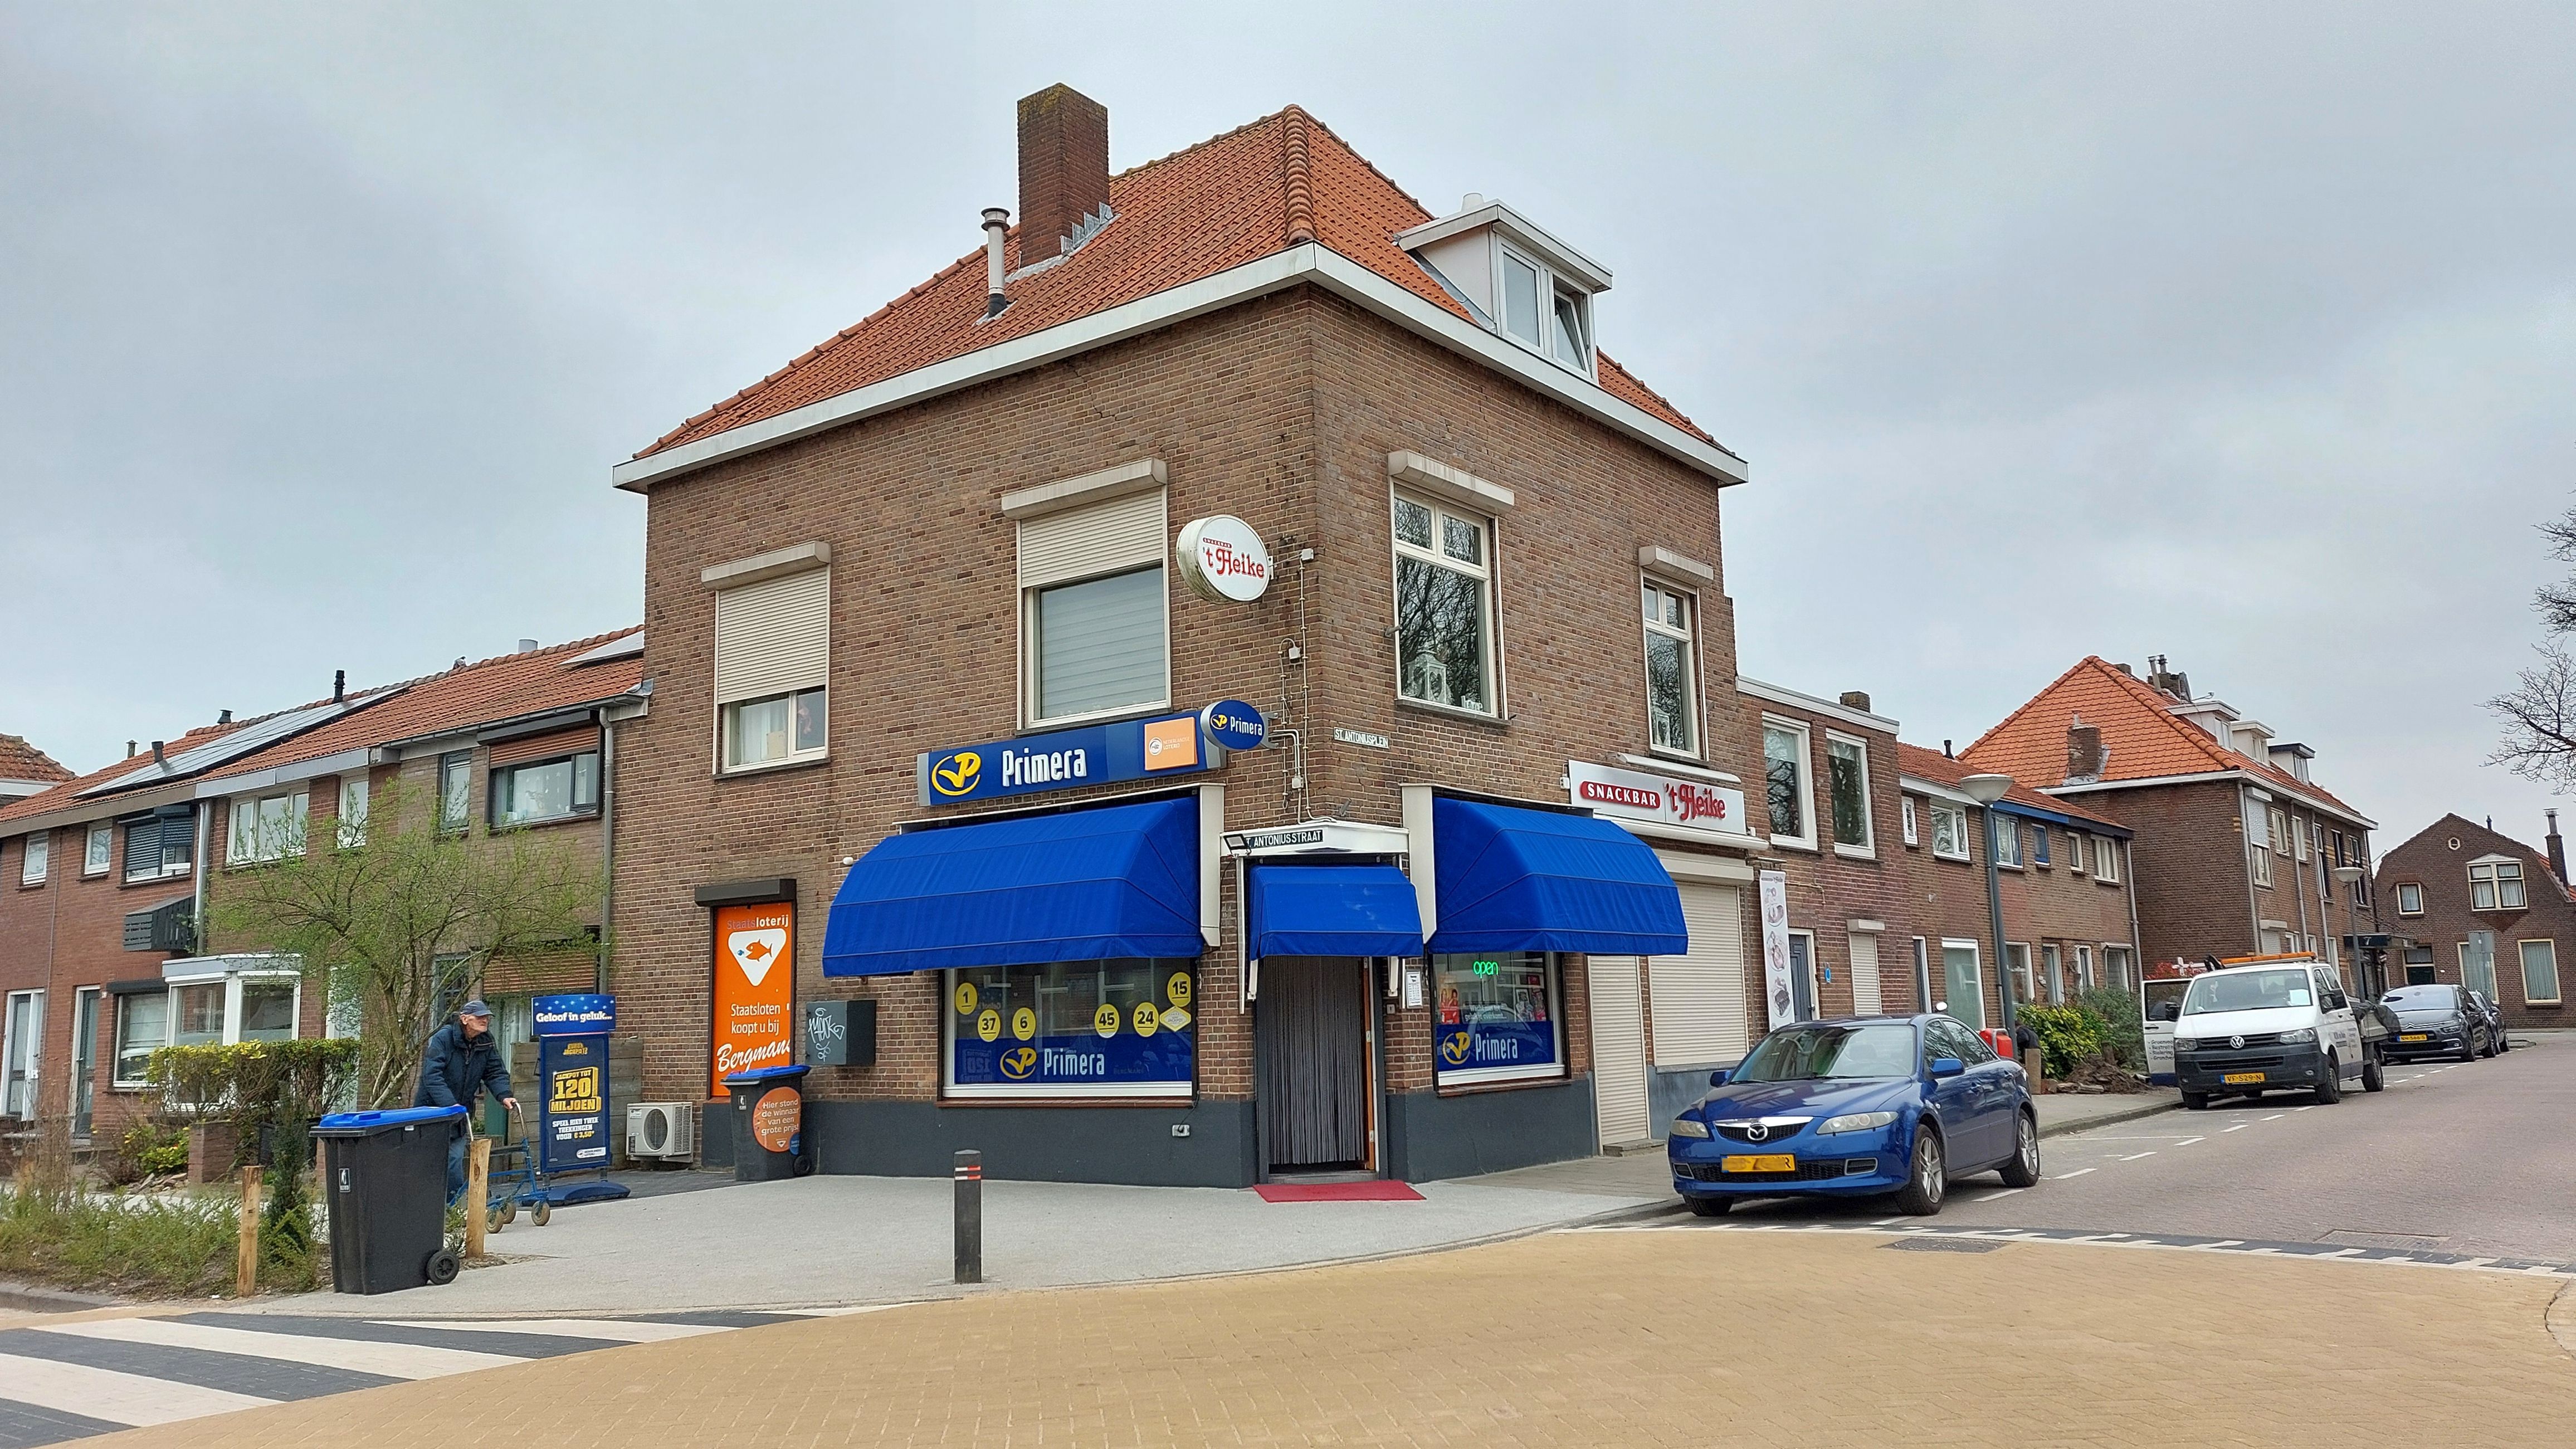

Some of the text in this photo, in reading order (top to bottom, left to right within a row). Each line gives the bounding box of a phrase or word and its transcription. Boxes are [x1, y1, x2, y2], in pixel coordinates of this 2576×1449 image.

[1203, 547, 1265, 579] 't Heike
[1230, 716, 1262, 736] Primera
[1345, 730, 1389, 748] ANTONIUSPLEIN
[1002, 748, 1087, 787] Primera
[1587, 783, 1657, 806] SNACKBAR
[1665, 783, 1726, 821] 't Heike
[1253, 830, 1321, 847] ANTONIUSSTRAAT
[727, 914, 789, 930] Staatsloterij
[1473, 961, 1499, 978] open
[1172, 981, 1188, 996] 15
[962, 991, 968, 1003] 1
[536, 1011, 612, 1023] Geloof in geluk...
[731, 1002, 780, 1017] Staatsloten
[982, 1018, 996, 1031] 37
[1019, 1017, 1028, 1029] 6
[1099, 1012, 1115, 1026] 45
[1137, 1011, 1154, 1025] 24
[731, 1018, 779, 1036] koopt u bij
[1476, 1033, 1518, 1061] Primera
[1044, 1048, 1105, 1076] Primera
[556, 1072, 579, 1080] JACKPOT
[555, 1077, 591, 1099] 120
[551, 1099, 596, 1111] MILJOEN
[780, 1099, 798, 1107] stond
[773, 1108, 799, 1116] winnaar
[761, 1126, 782, 1136] grote
